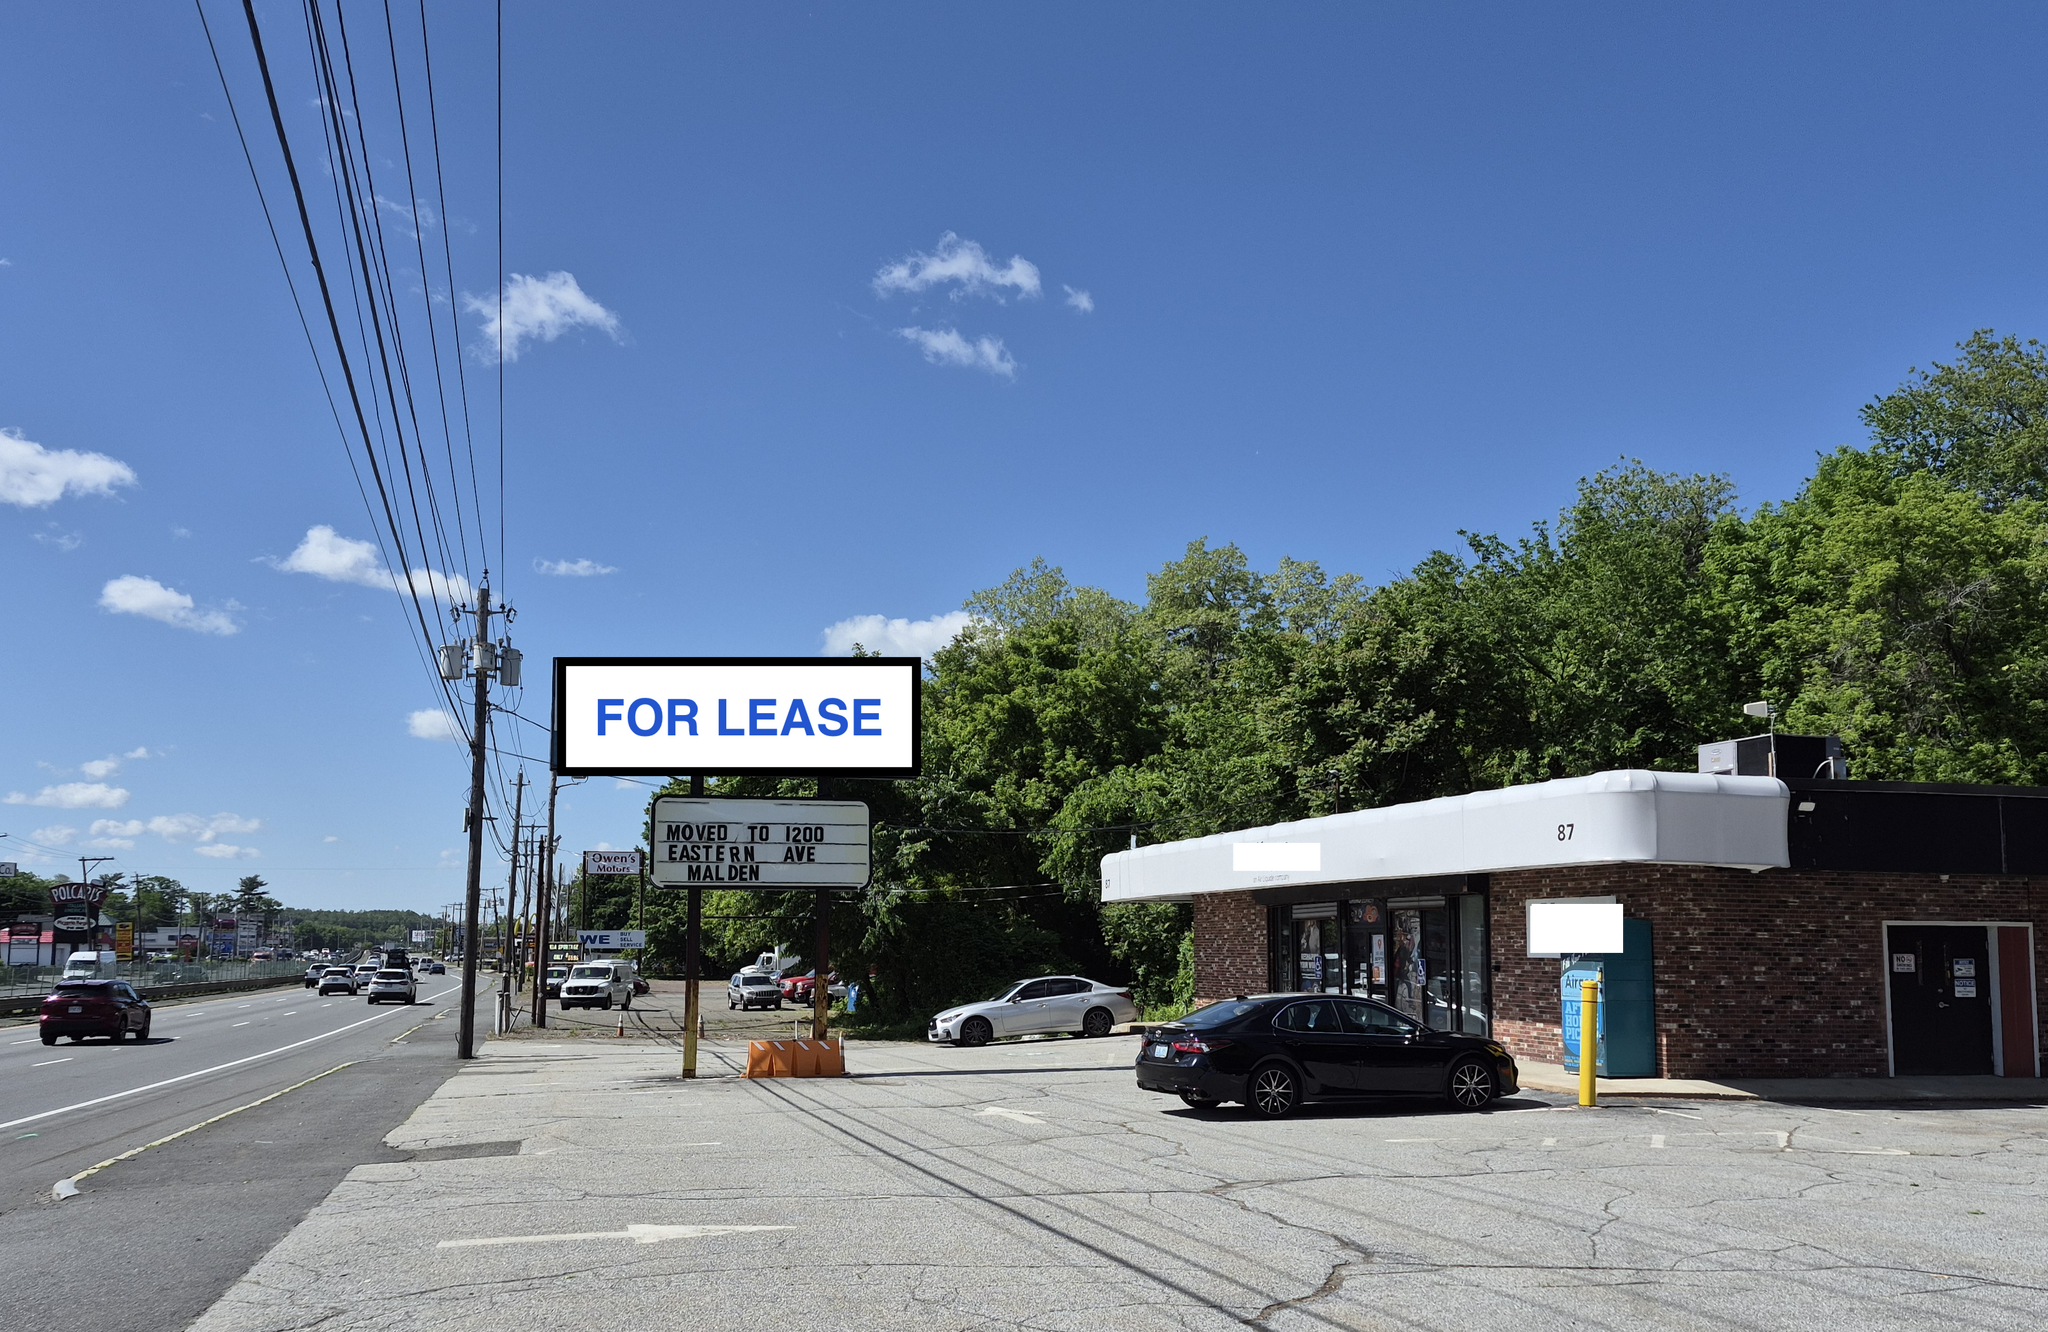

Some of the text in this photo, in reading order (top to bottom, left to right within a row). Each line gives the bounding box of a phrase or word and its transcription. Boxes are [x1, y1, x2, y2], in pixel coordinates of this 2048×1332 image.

[597, 697, 882, 737] FOR LEASE
[666, 824, 824, 842] MOVED TO 1200
[1557, 823, 1575, 841] 87
[592, 853, 636, 863] Owen's
[668, 844, 816, 862] EASTERN AVE
[596, 864, 631, 873] Motors
[687, 864, 760, 881] MALDEN
[580, 934, 611, 945] WE
[1896, 955, 1906, 963] NO
[1565, 974, 1594, 991] Airg
[1565, 1001, 1582, 1014] AFT
